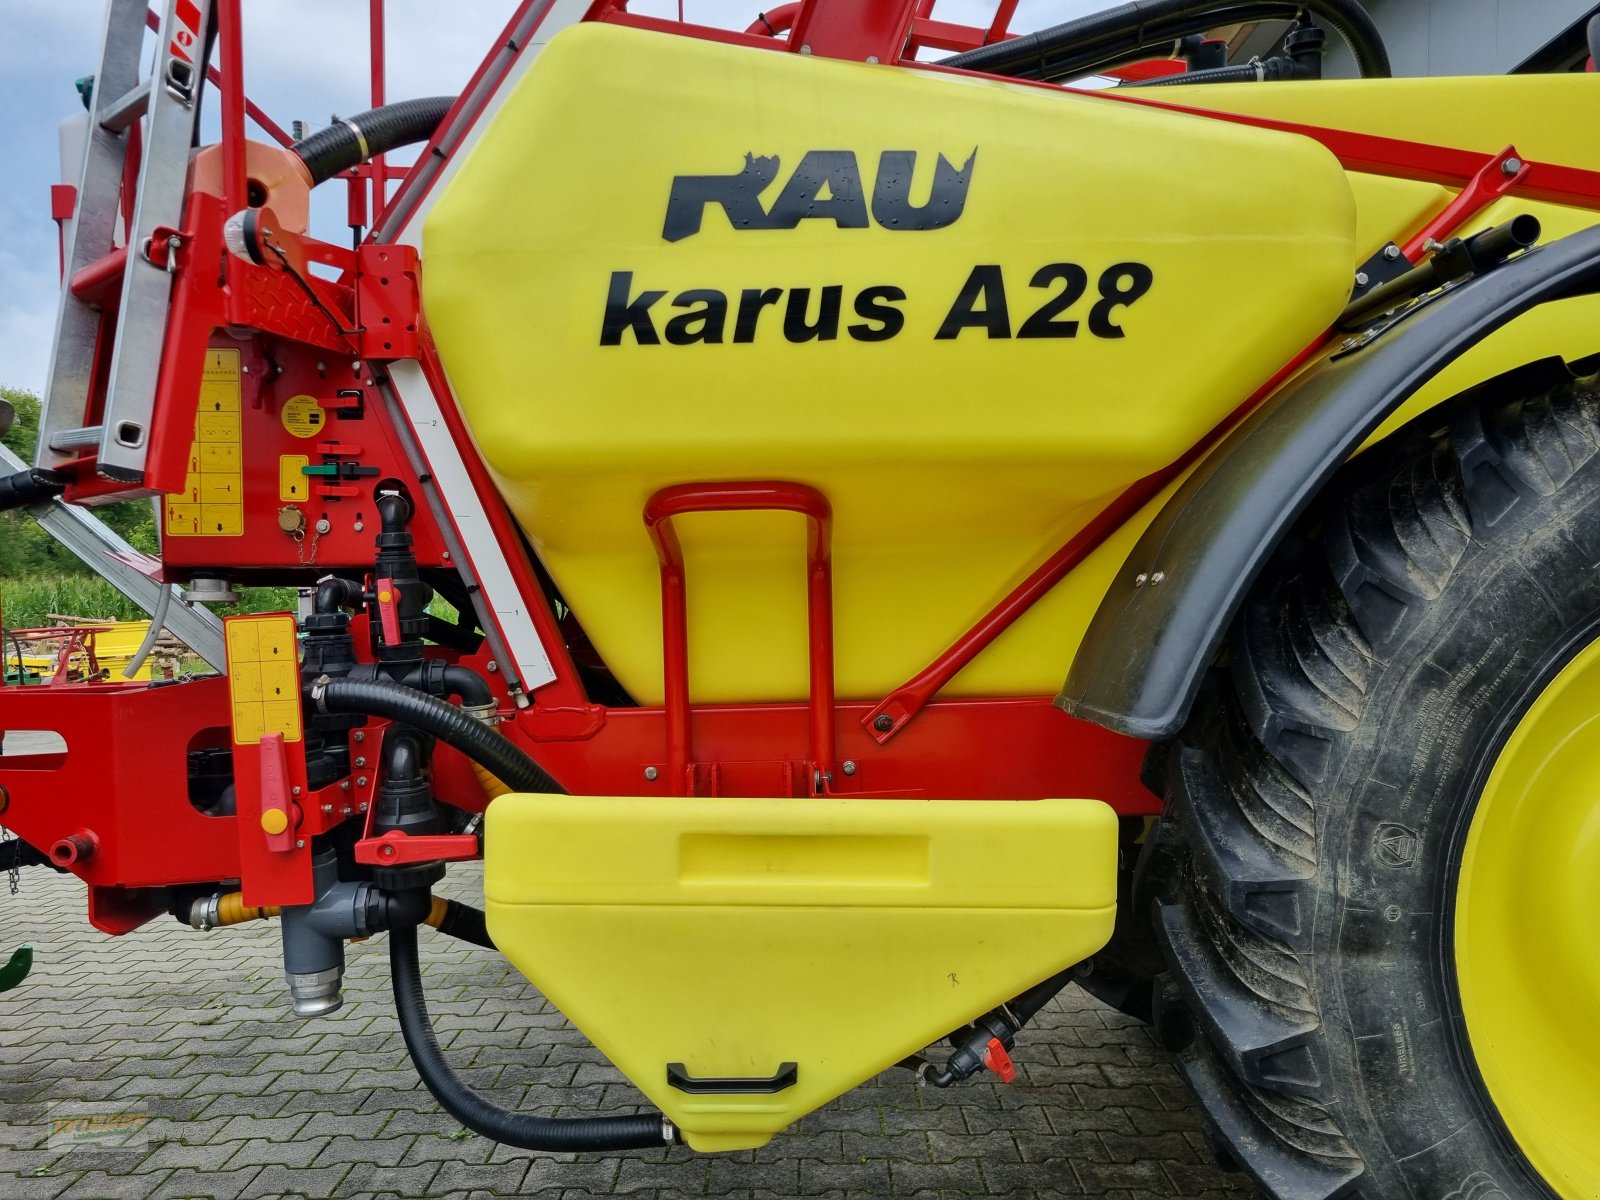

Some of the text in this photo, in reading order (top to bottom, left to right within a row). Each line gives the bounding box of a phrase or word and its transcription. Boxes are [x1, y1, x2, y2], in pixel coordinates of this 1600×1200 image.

[661, 144, 979, 243] RAU
[599, 262, 1154, 347] karus A28
[432, 419, 437, 427] 2
